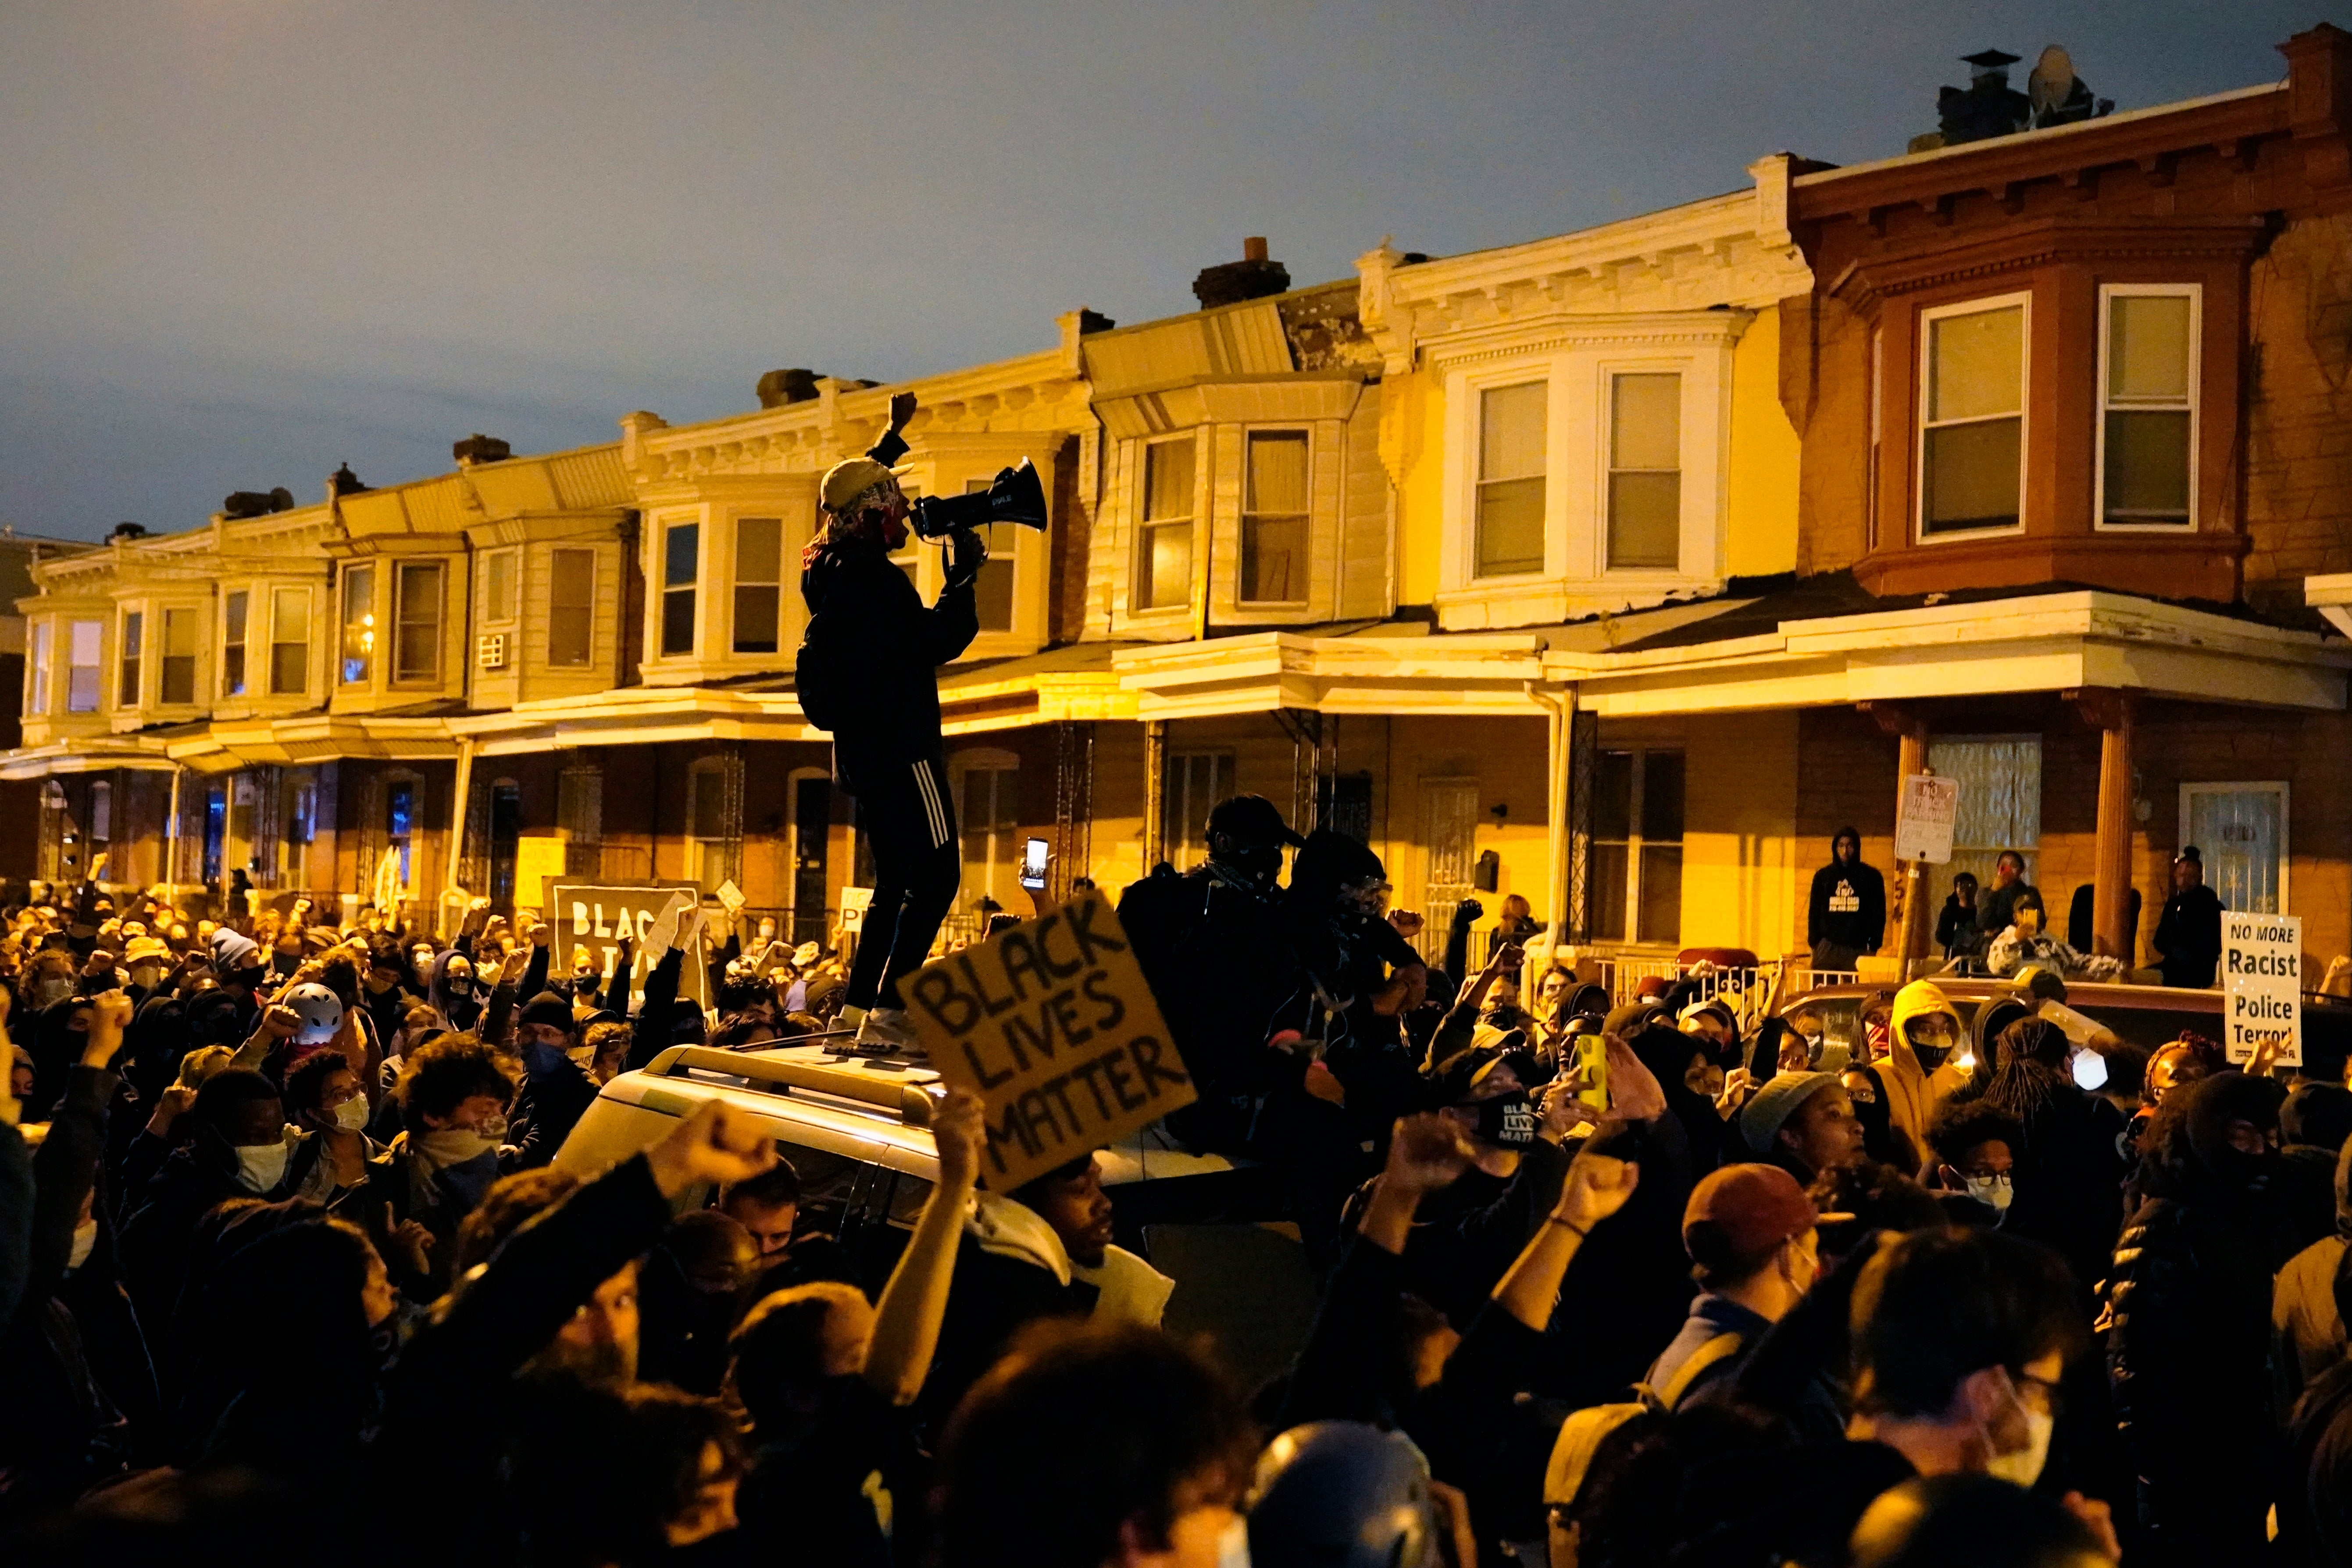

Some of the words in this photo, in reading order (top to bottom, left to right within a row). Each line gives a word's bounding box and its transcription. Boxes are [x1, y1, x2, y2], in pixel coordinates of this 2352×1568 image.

[573, 901, 655, 943] BLAC
[2231, 924, 2252, 940] NO
[2256, 926, 2294, 943] MORE
[913, 899, 1126, 1037] BLACK
[2228, 948, 2297, 977] Racist
[2235, 995, 2292, 1019] Police
[961, 970, 1125, 1090] LIVES
[984, 1036, 1189, 1174] MATTER
